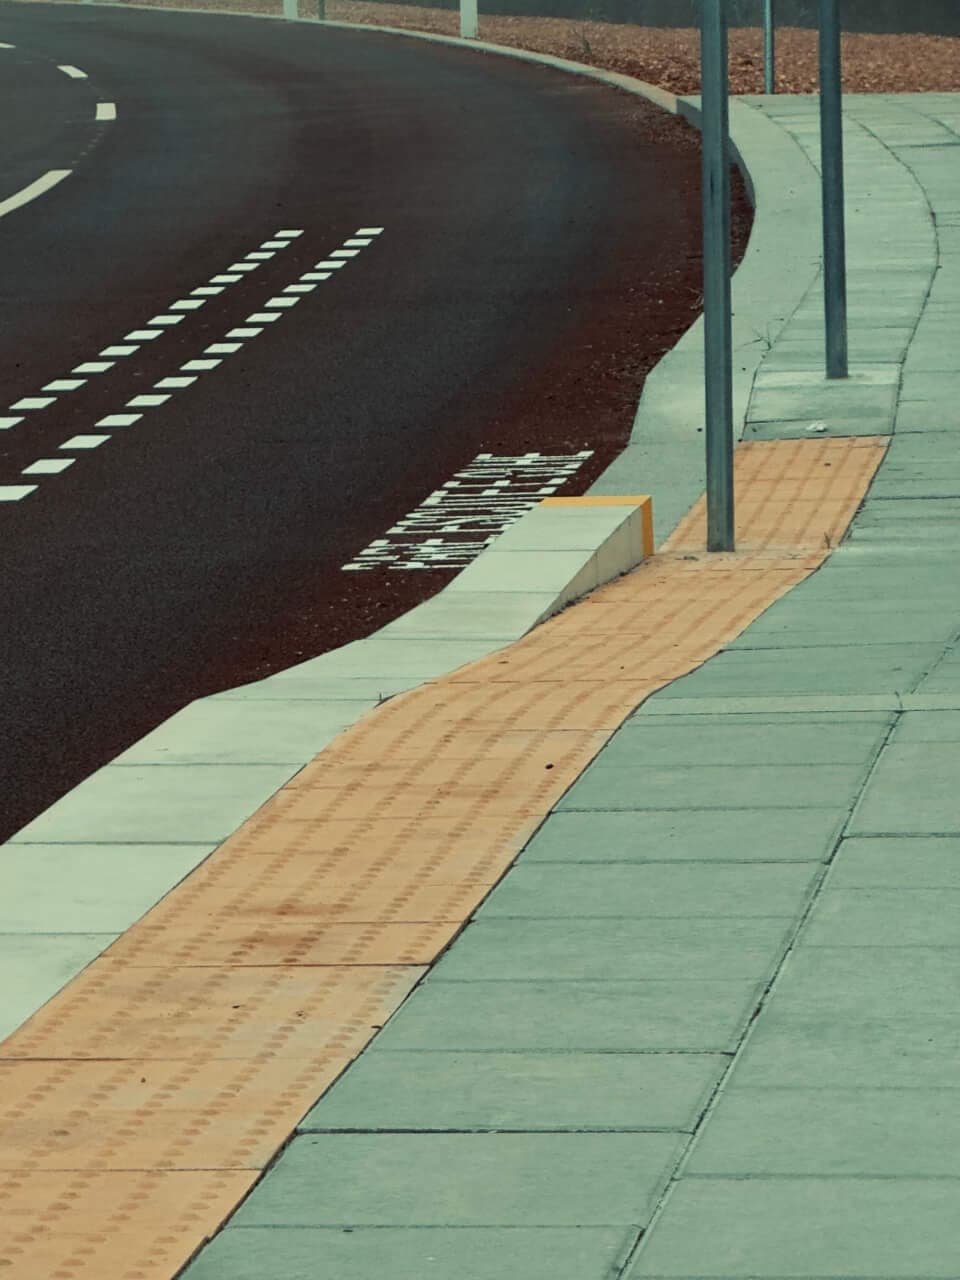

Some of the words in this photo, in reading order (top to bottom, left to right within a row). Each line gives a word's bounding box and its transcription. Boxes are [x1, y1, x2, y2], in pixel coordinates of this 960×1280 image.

[453, 450, 595, 478] OLHE
[441, 477, 568, 488] E
[385, 487, 558, 534] ESCUTE
[341, 535, 500, 570] PARE
